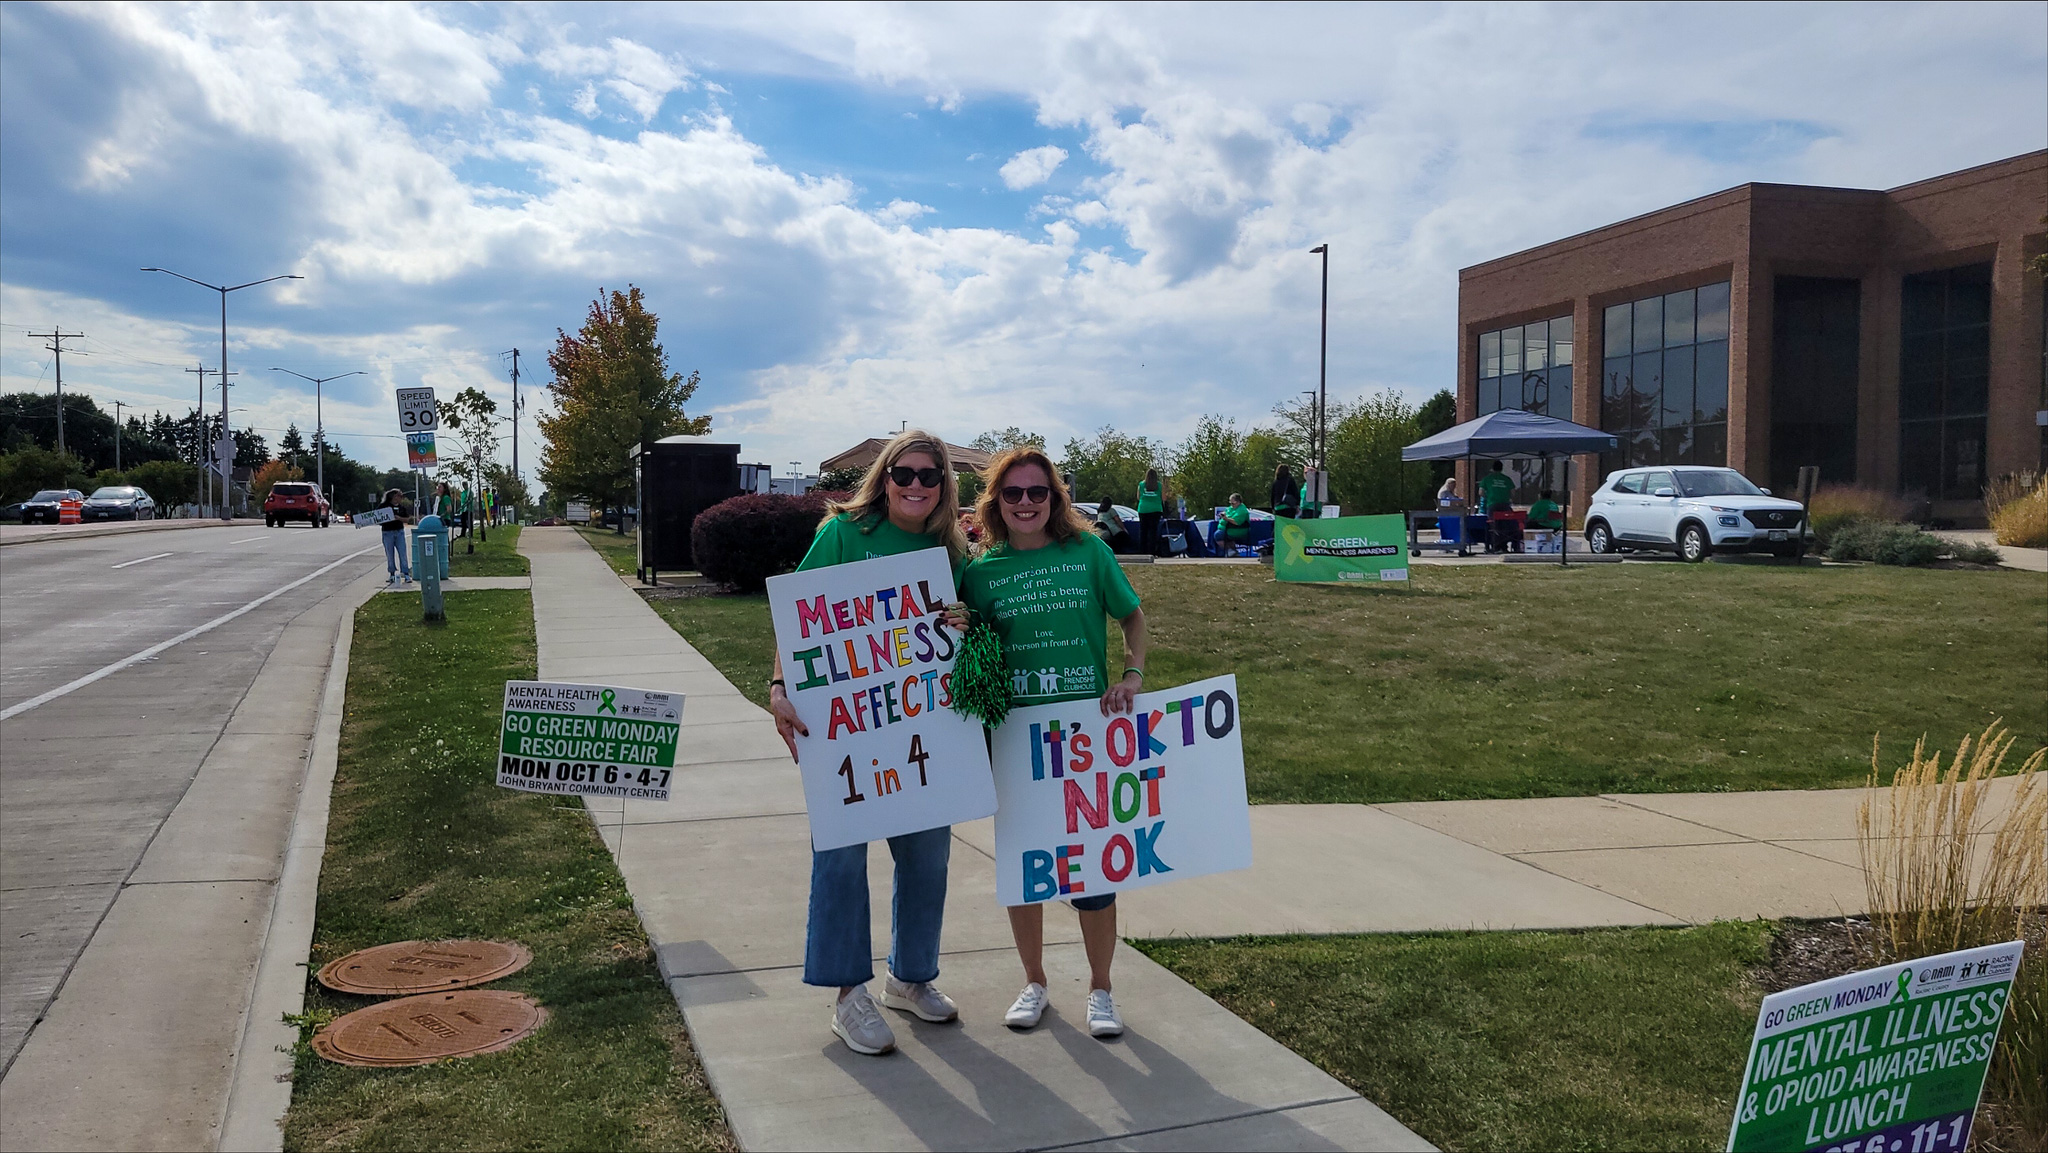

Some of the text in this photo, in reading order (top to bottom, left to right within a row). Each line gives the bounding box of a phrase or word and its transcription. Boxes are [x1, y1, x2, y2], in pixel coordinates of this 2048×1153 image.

[400, 392, 431, 401] SPEED
[404, 401, 429, 409] LIMIT
[403, 410, 433, 427] 30
[407, 434, 434, 443] RYDE
[1305, 547, 1332, 555] MENTAL
[1357, 546, 1396, 555] AWARENESS
[1312, 538, 1328, 547] GO
[1329, 537, 1368, 548] GREEN
[988, 563, 1086, 589] Dear person in front
[1022, 580, 1034, 590] of
[1008, 592, 1037, 604] world
[1039, 590, 1048, 599] is
[1059, 587, 1089, 596] better
[1021, 603, 1044, 614] with
[1046, 602, 1066, 613] you
[1068, 599, 1077, 608] in
[795, 580, 946, 638] MENTAL
[793, 618, 955, 691] ILLNESS
[1012, 642, 1040, 651] Person
[1050, 639, 1069, 648] front
[1071, 637, 1079, 646] of
[1064, 665, 1095, 677] RACINE
[1064, 676, 1096, 684] FRIENDSHIP
[509, 687, 600, 700] MENTAL HEALTH
[1064, 683, 1096, 691] CLUBHOUSE
[507, 699, 576, 711] AWARENESS
[827, 669, 953, 740] AFFECTS
[505, 714, 678, 744] GO GREEN MONDAY
[1106, 709, 1167, 768] OK
[1165, 689, 1234, 747] TO
[520, 737, 658, 764] RESOURCE FAIR
[501, 756, 670, 788] MON OCT 6 4-7
[838, 734, 930, 806] 1 in 4
[500, 775, 668, 799] JOHN BRYANT COMMUNITY CENTER
[1063, 765, 1166, 835] NOT
[1022, 820, 1175, 903] BE OK
[1764, 980, 1893, 1029] GO GREEN MONDAY
[1752, 988, 2005, 1085] MENTAL ILLNESS
[1740, 1033, 1994, 1124] & OPIOID AWARENESS
[1805, 1082, 1912, 1146] LUNCH
[1910, 1115, 1965, 1152] 11-1
